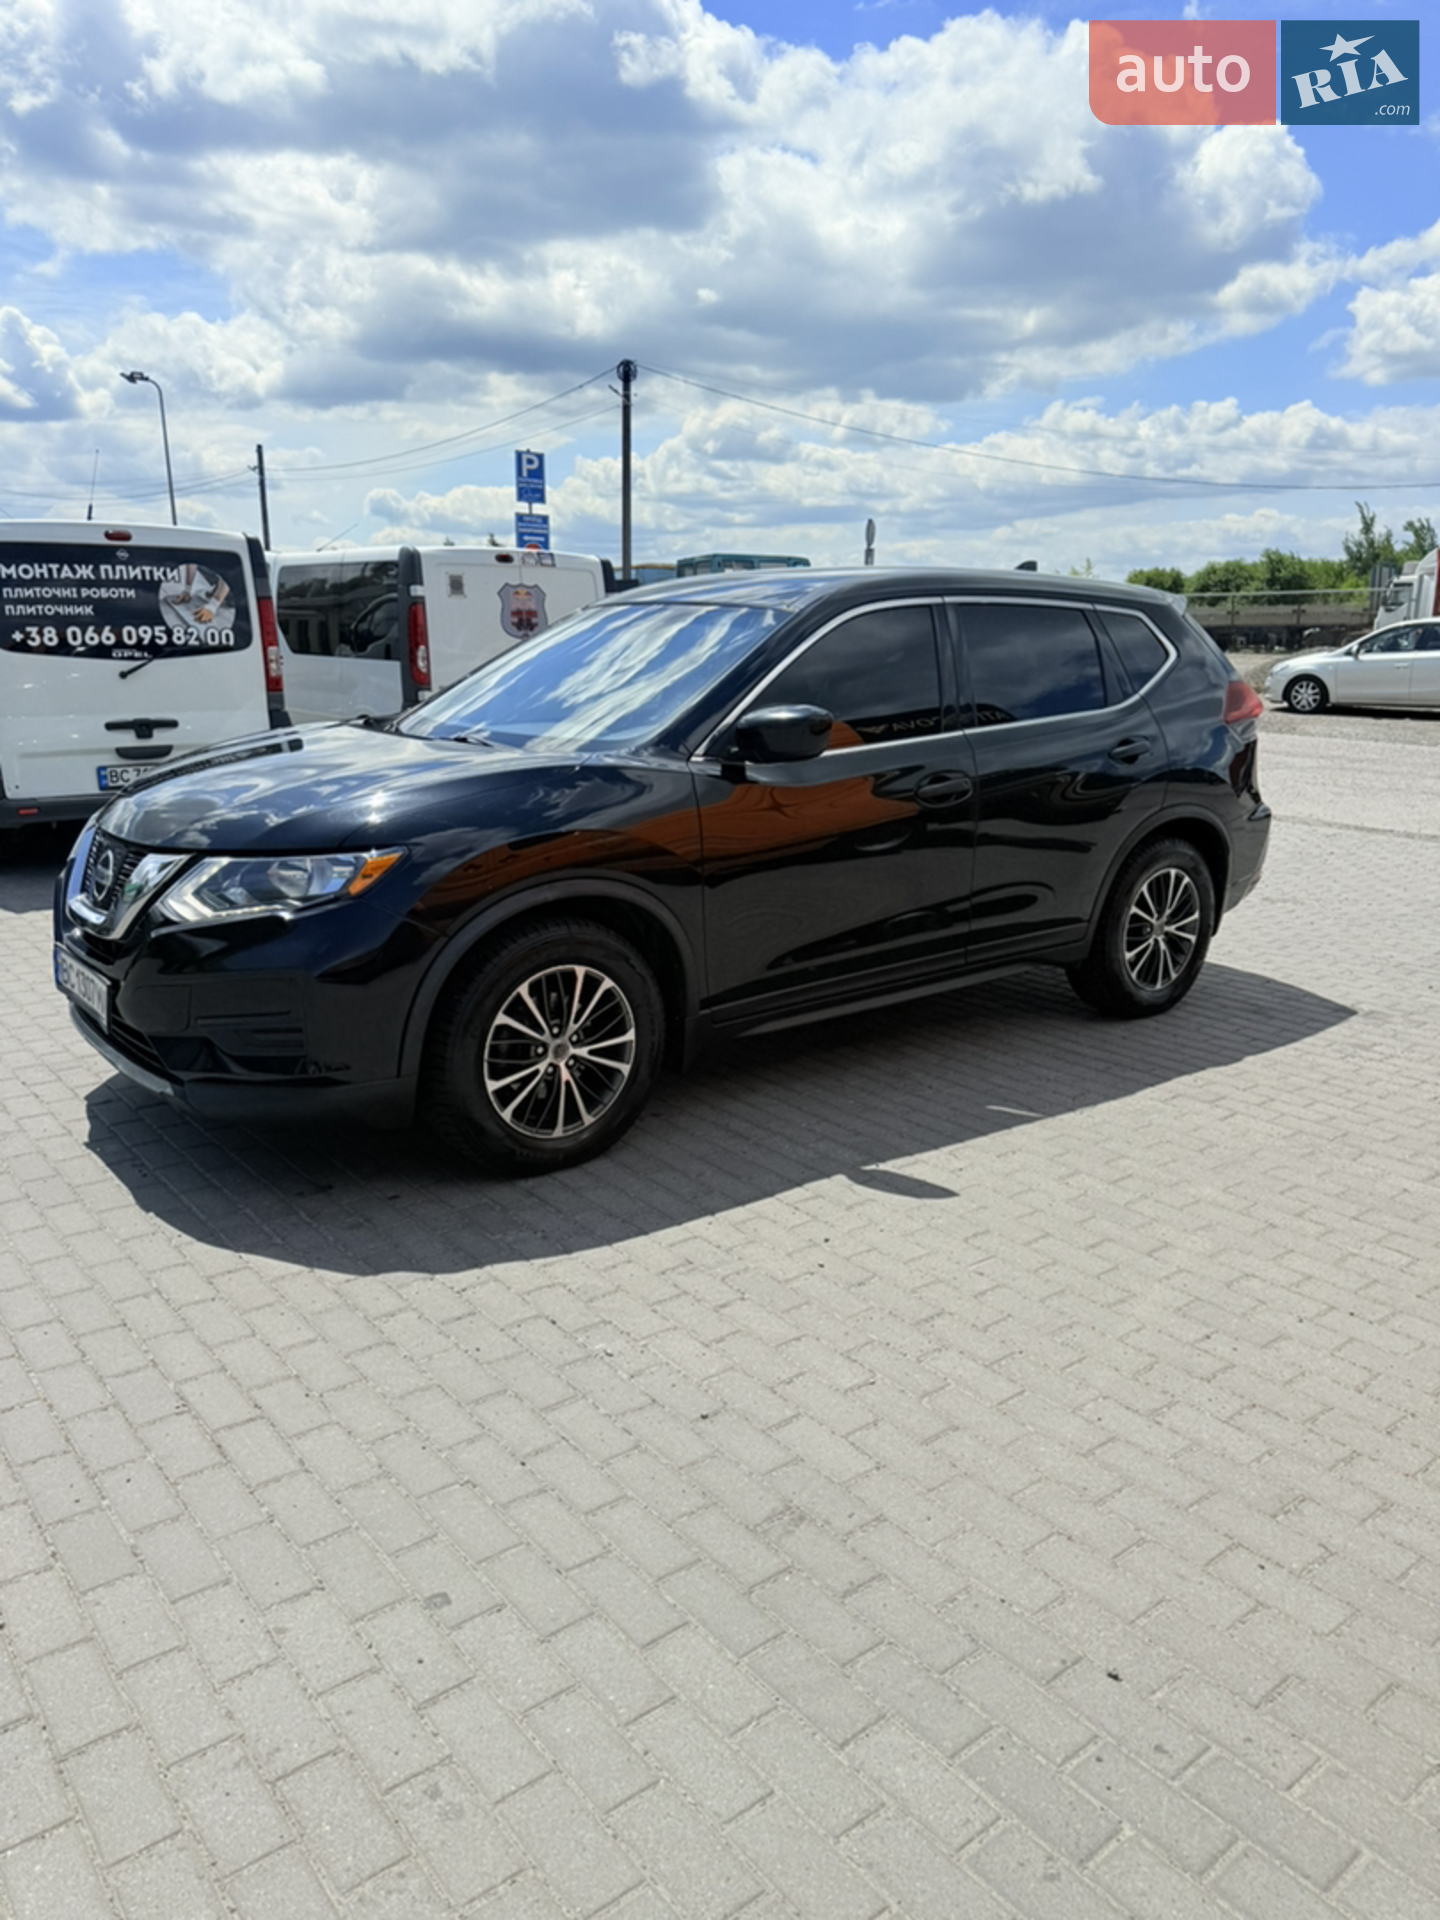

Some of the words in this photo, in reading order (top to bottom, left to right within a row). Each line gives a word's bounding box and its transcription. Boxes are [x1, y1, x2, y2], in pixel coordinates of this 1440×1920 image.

[521, 453, 540, 478] P
[0, 562, 96, 580] МОНТАЖ
[99, 564, 180, 583] ПЛИТКИ
[2, 586, 79, 599] ПЛИТОЧНІ
[80, 587, 136, 599] РОБОТИ
[4, 603, 95, 616] ПЛИТОЧНИК
[11, 625, 60, 647] +38
[65, 625, 117, 647] 066
[121, 625, 168, 646] 095
[171, 626, 200, 646] 82
[109, 769, 131, 784] BC
